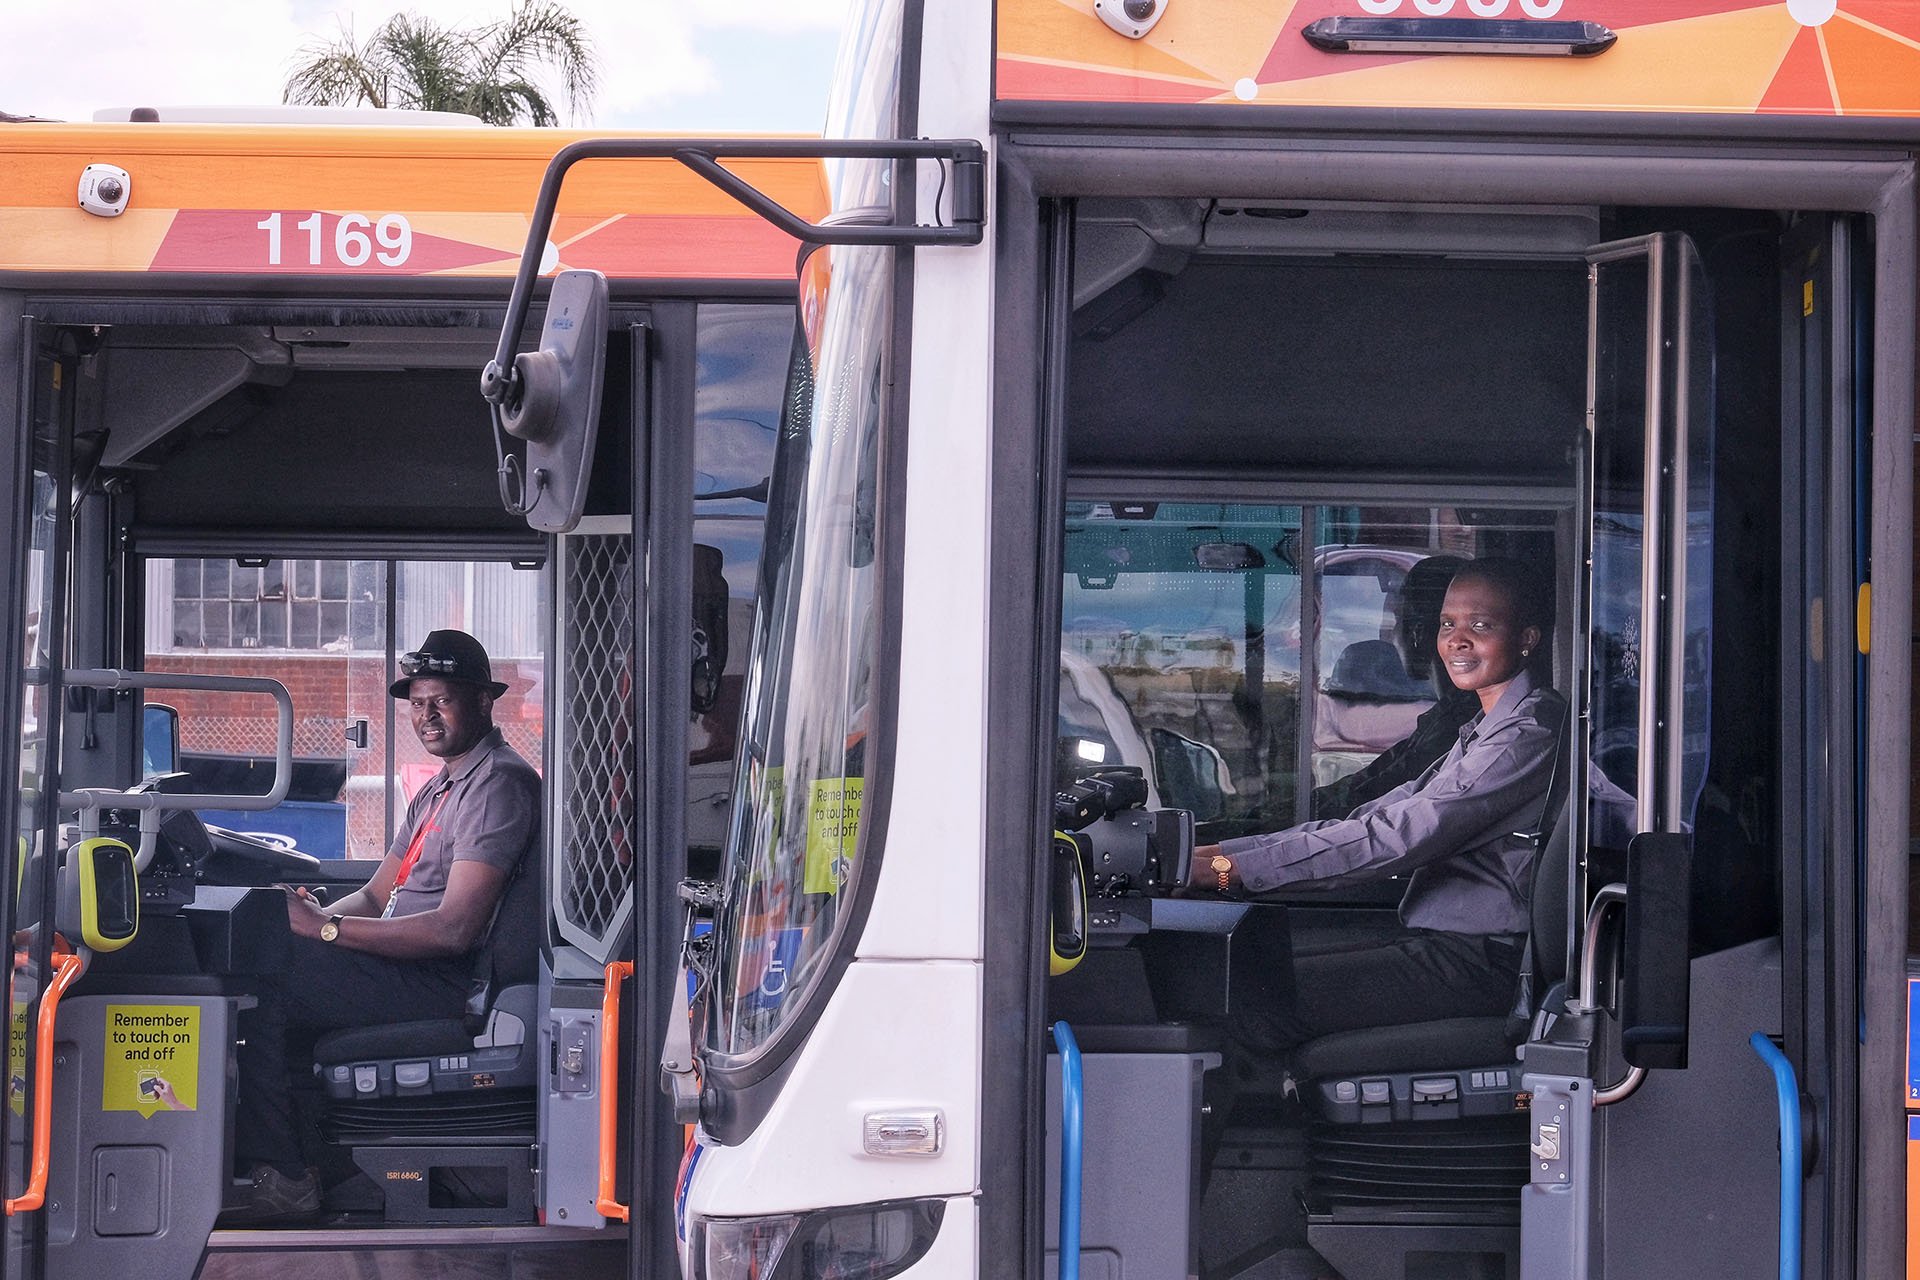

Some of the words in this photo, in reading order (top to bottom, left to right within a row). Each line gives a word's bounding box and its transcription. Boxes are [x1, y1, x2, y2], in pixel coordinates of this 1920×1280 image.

[257, 213, 413, 266] 1169
[817, 786, 863, 802] Remembe
[814, 808, 824, 820] to
[826, 805, 854, 819] touch
[822, 823, 840, 838] and
[841, 822, 858, 836] off
[114, 1013, 190, 1027] Remember
[113, 1031, 126, 1043] to
[130, 1030, 169, 1043] touch
[173, 1033, 190, 1043] on
[125, 1047, 150, 1060] and
[153, 1047, 175, 1060] off
[401, 1171, 420, 1180] 6860
